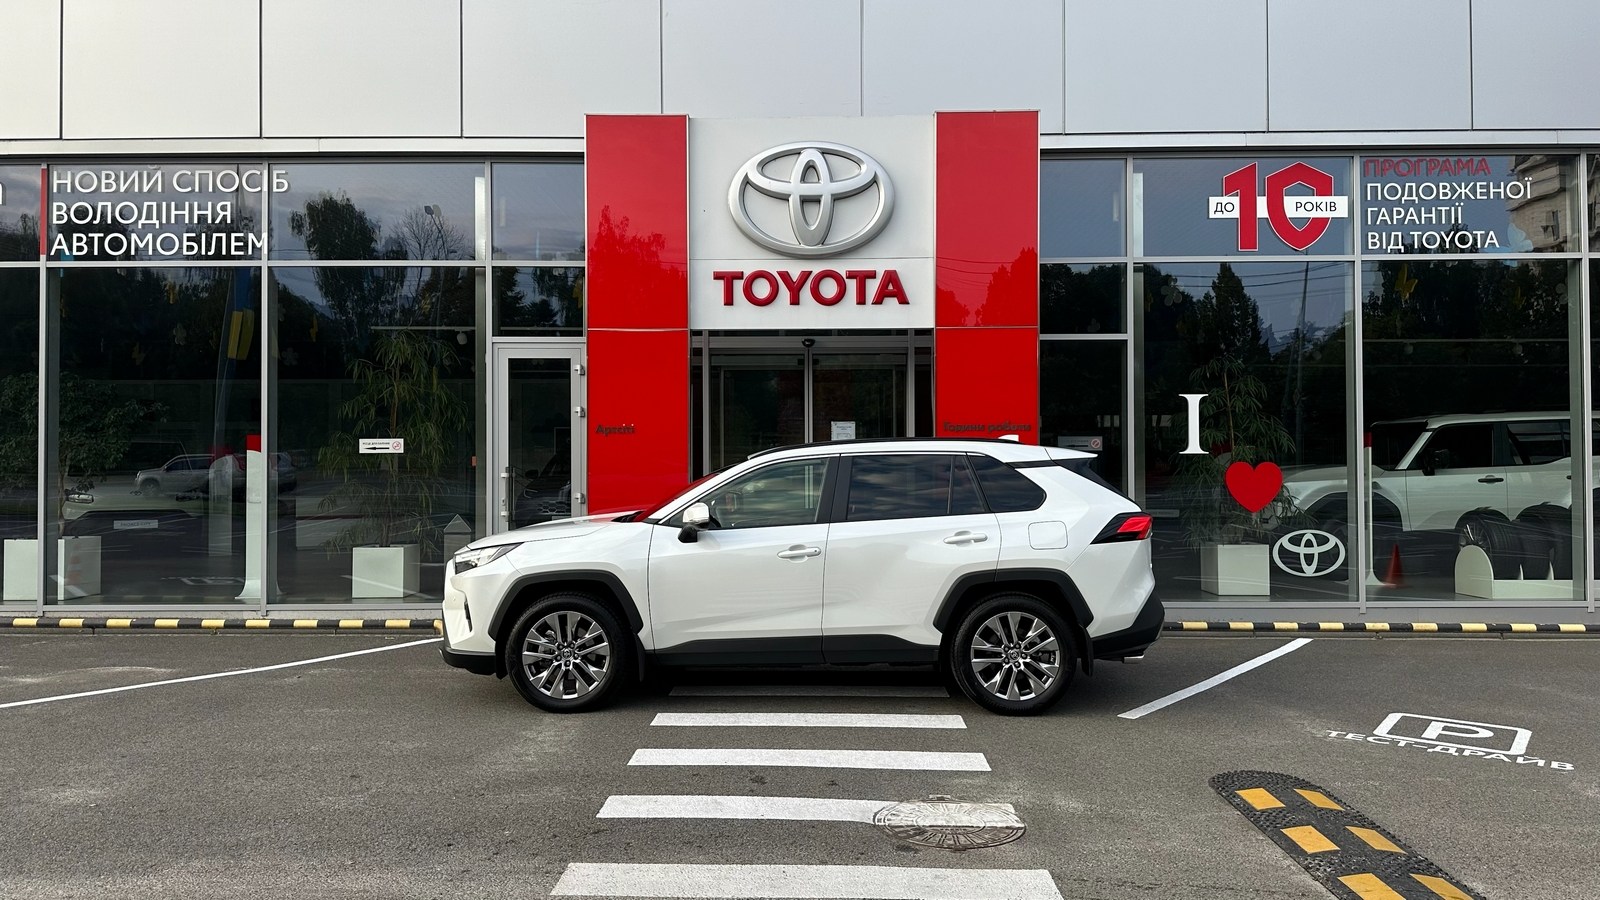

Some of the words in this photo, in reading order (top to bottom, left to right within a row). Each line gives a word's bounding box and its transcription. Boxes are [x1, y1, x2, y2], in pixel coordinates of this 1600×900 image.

[1365, 157, 1491, 176] ПРОГРАМА
[52, 165, 162, 193] НОВИЙ
[172, 169, 289, 193] СПОСІБ
[1367, 177, 1532, 204] ПОДОВЖЕНОЇ
[52, 201, 232, 229] ВОЛОДІННЯ
[1213, 202, 1235, 214] ДО
[1223, 161, 1334, 251] 10
[1295, 201, 1337, 212] РОКІВ
[1367, 202, 1464, 225] ГАРАНТІЇ
[50, 232, 268, 256] АВТОМОБІЛЕМ
[1368, 231, 1404, 253] ВІД
[1410, 230, 1500, 249] TOYOTA
[713, 269, 910, 307] TOYOTA
[943, 421, 985, 432] Години
[987, 420, 1031, 433] роботи
[1178, 393, 1210, 454] I
[1421, 720, 1494, 739] P
[1326, 729, 1575, 771] ТЕСТ-ДРАЙВ
